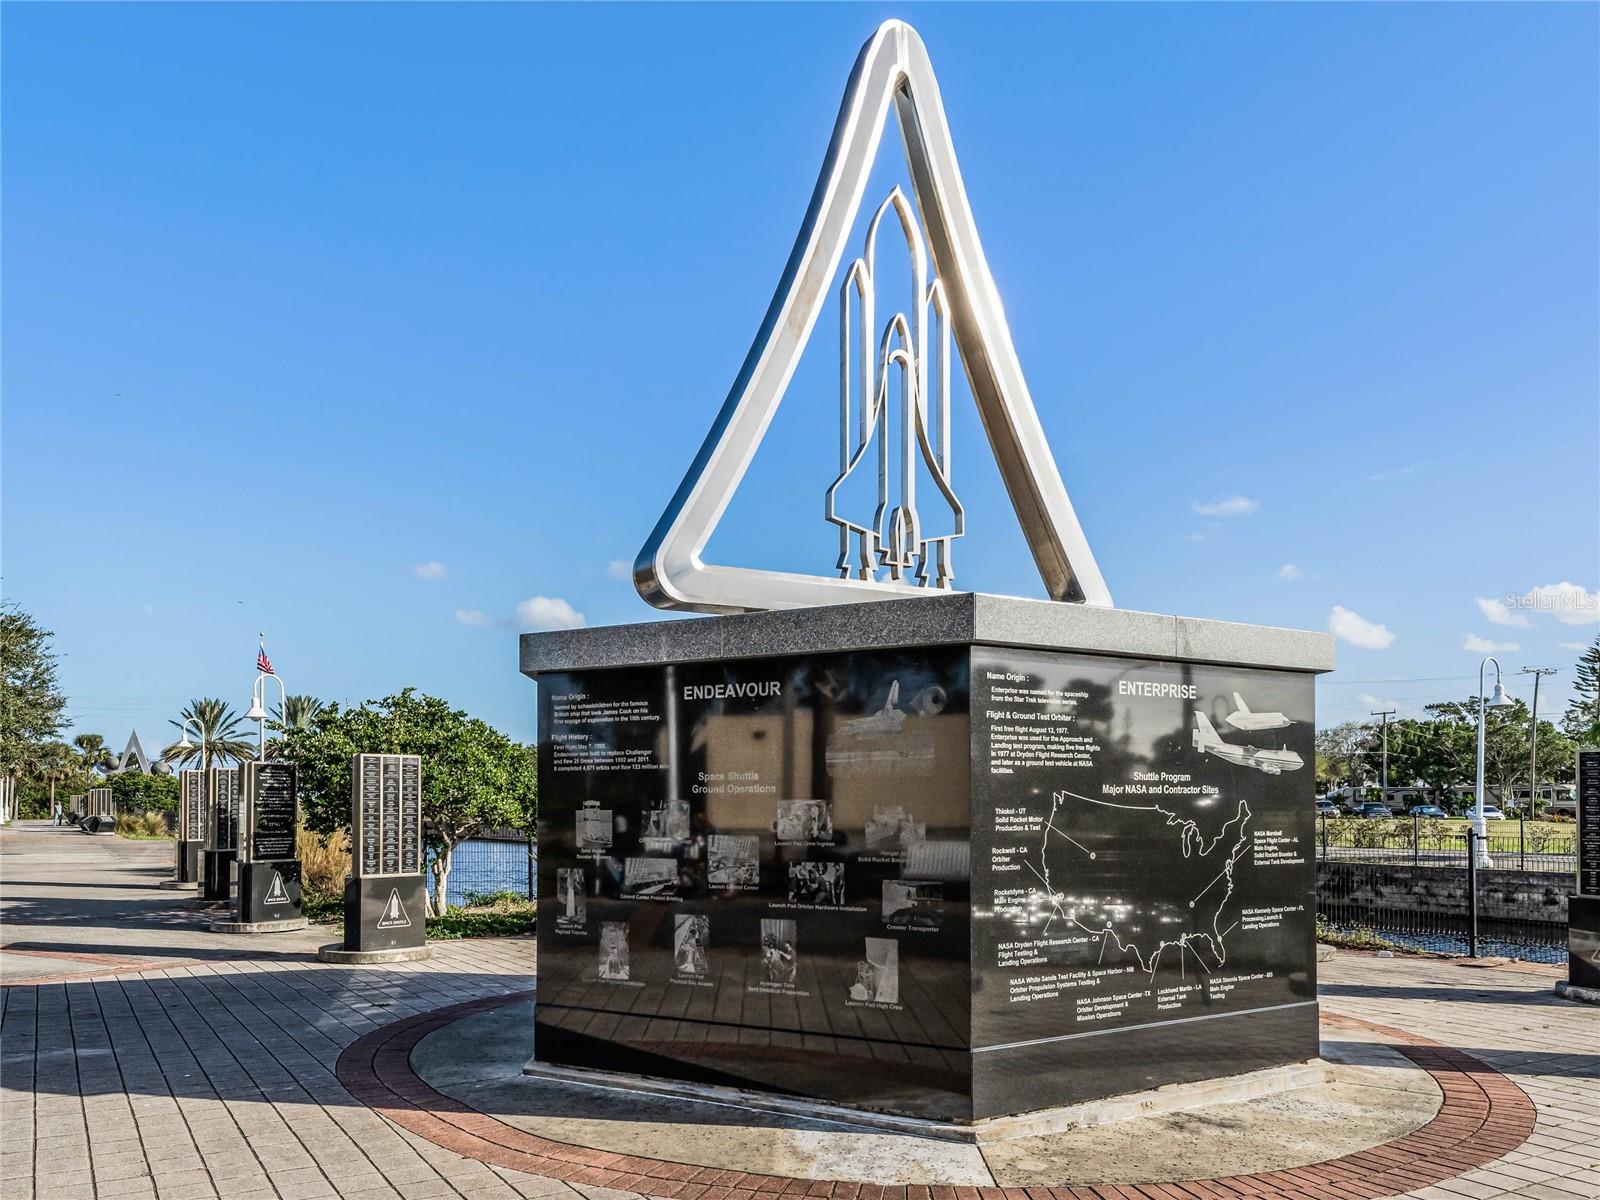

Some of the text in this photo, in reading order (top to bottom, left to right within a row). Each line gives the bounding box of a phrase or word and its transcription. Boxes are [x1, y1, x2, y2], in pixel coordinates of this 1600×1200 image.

[987, 672, 1025, 682] Name Origin
[684, 681, 781, 700] ENDEAVOUR
[1119, 680, 1197, 699] ENTERPRISE
[986, 711, 1004, 719] Flight
[1012, 712, 1035, 720] Ground
[698, 772, 725, 782] Space
[1134, 772, 1190, 783] Shuttle Program
[692, 785, 776, 794] Ground Operations
[1103, 784, 1219, 796] Major NASA and Contractor Sites
